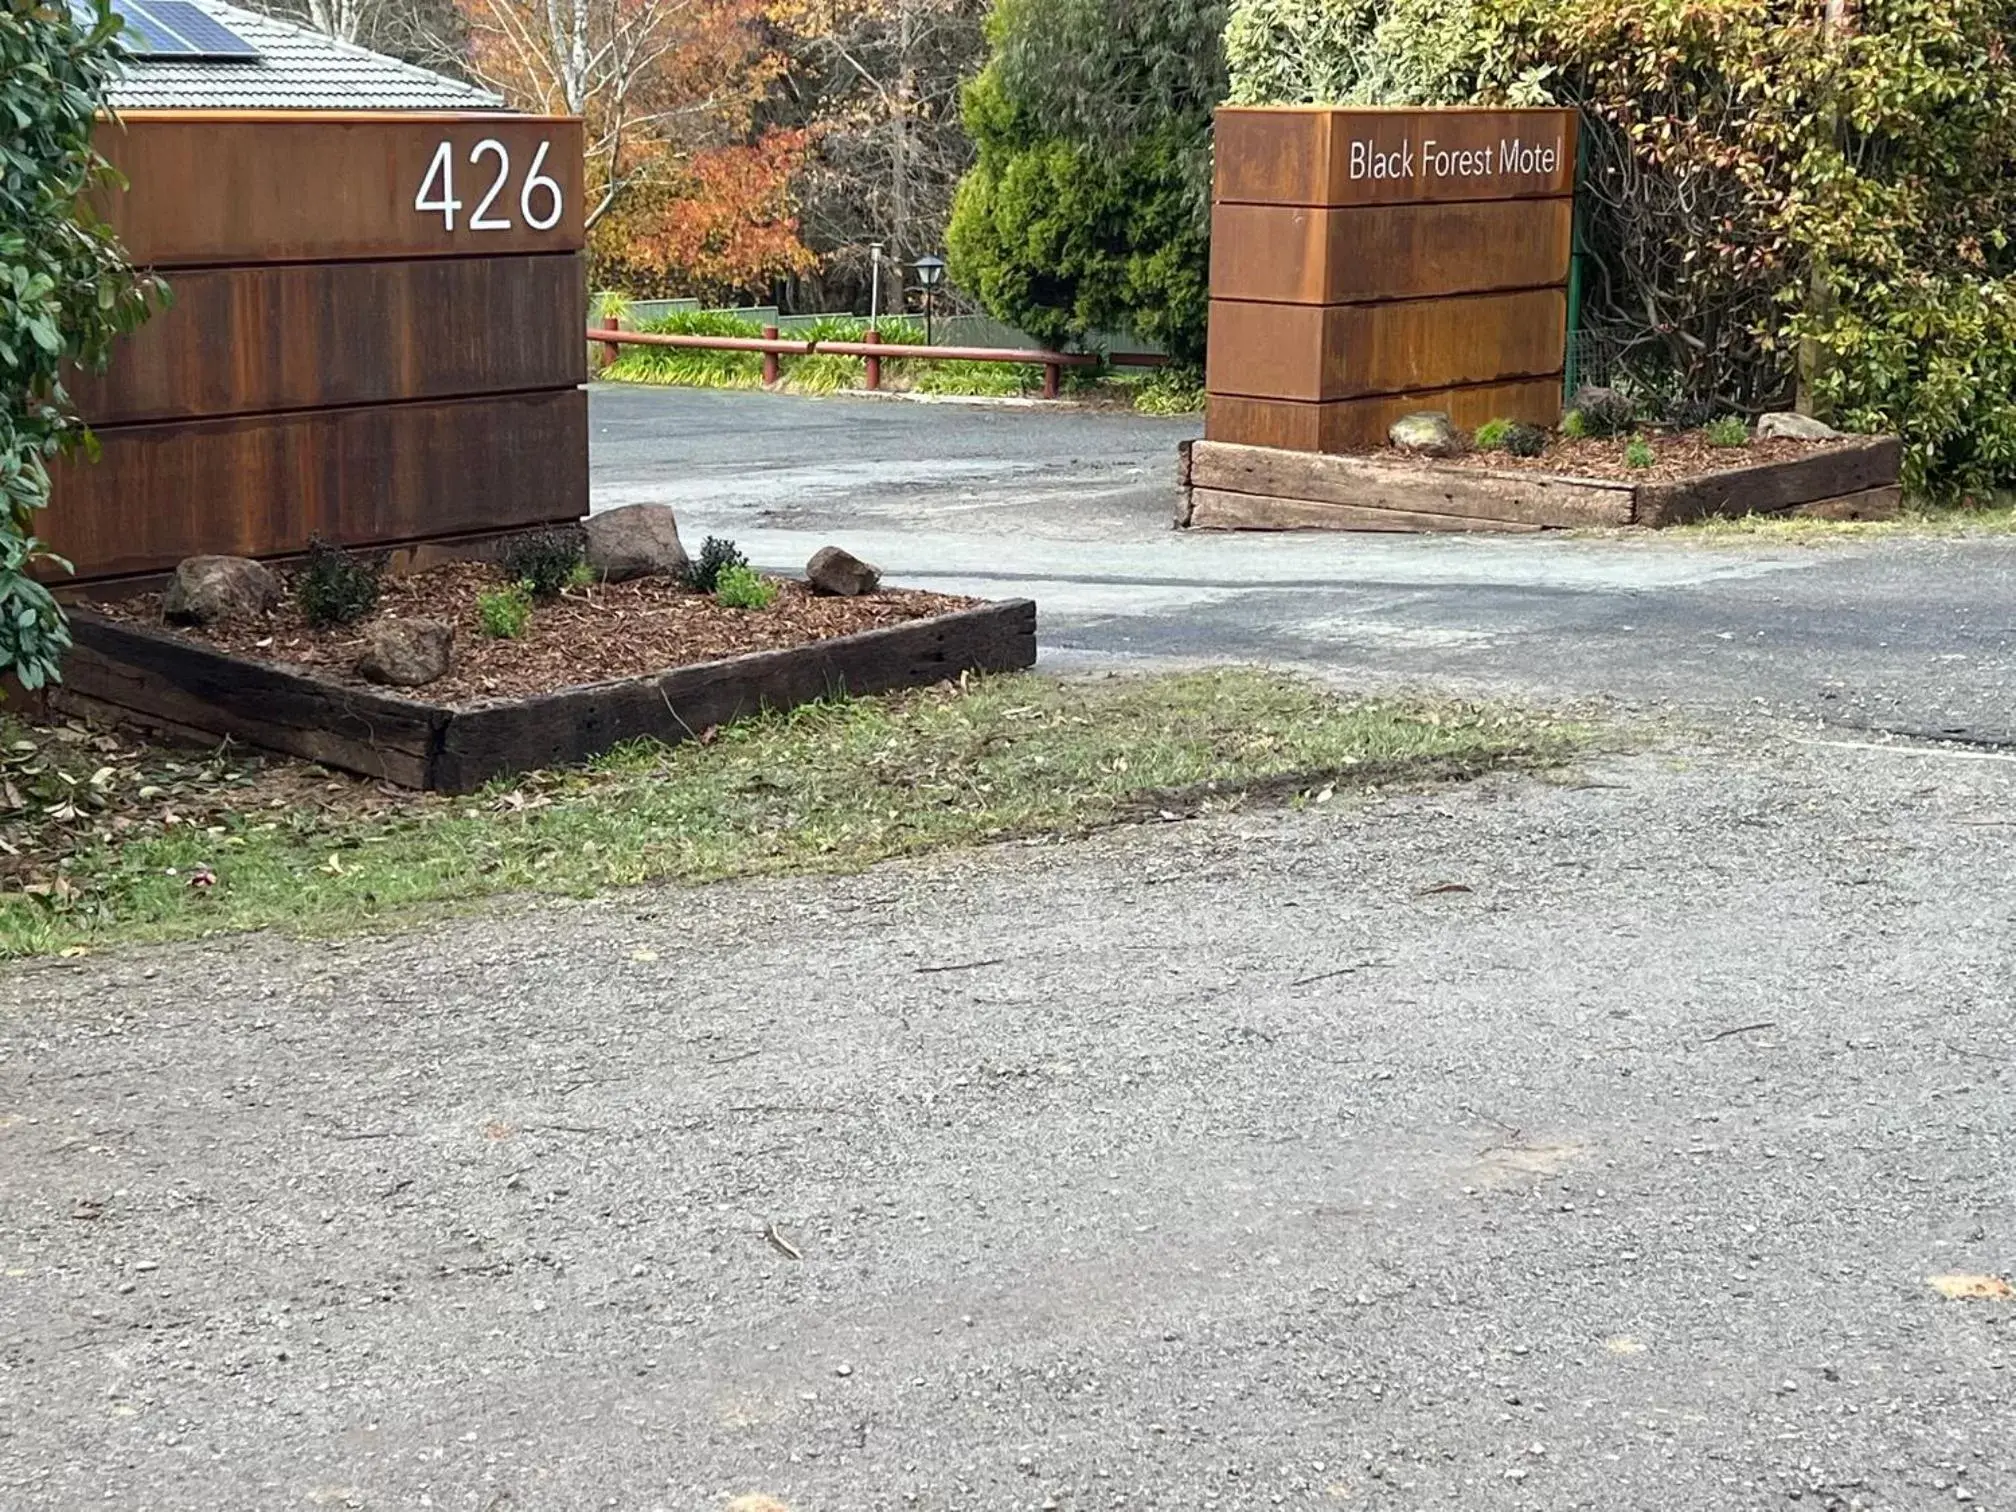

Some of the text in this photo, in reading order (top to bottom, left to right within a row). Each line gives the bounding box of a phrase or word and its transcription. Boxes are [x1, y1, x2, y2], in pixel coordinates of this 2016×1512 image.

[414, 138, 564, 231] 426
[1350, 136, 1561, 179] Black Forest Motel
